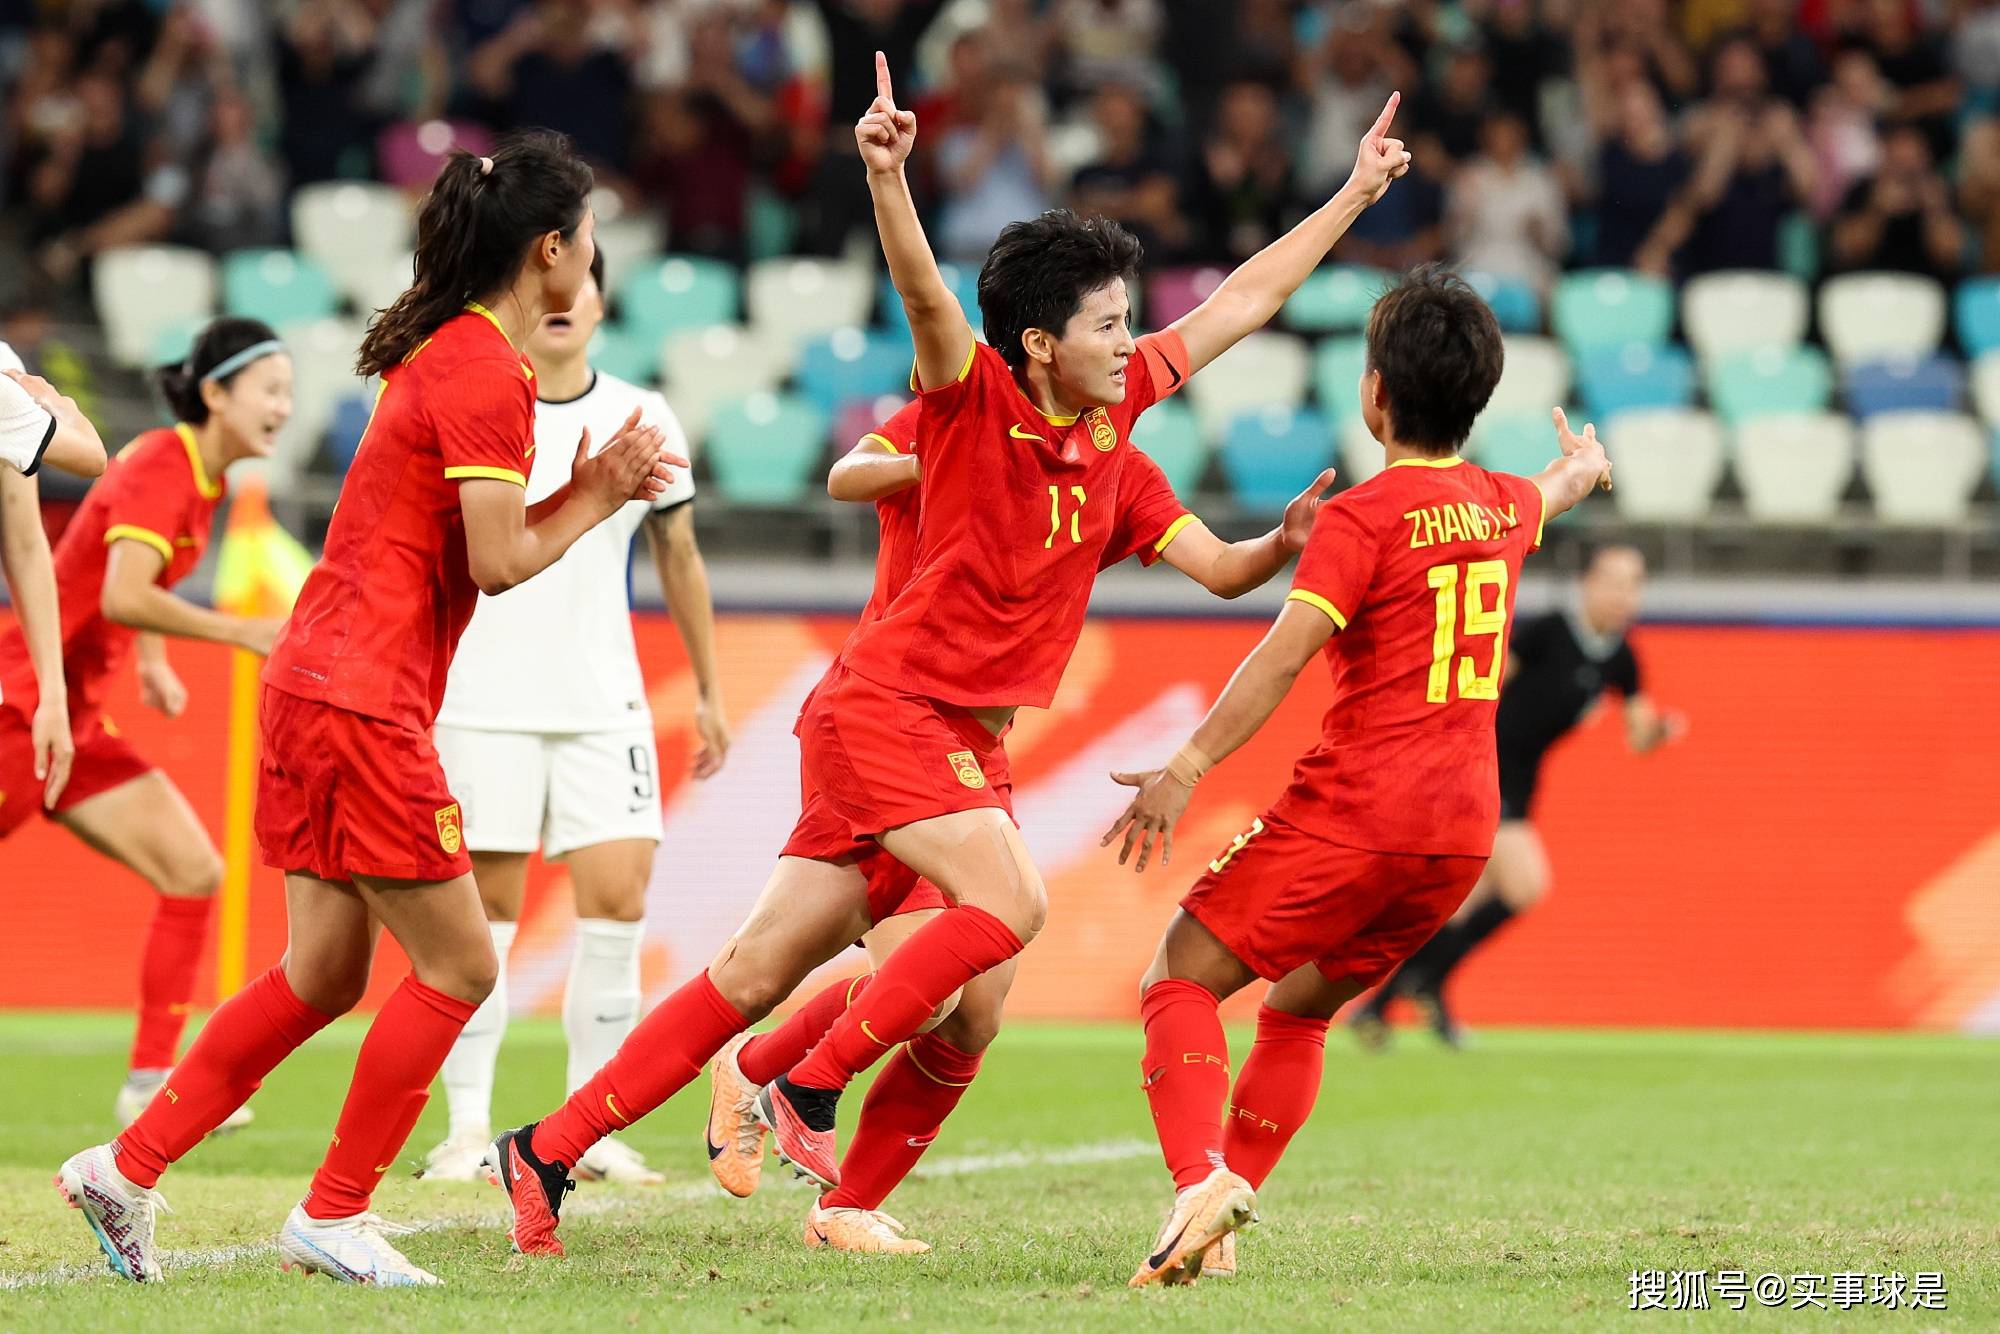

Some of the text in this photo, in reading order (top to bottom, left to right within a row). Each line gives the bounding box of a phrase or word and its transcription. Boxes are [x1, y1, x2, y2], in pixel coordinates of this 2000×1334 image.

[1044, 485, 1087, 549] 11
[1426, 559, 1508, 703] 19
[628, 744, 653, 799] 9
